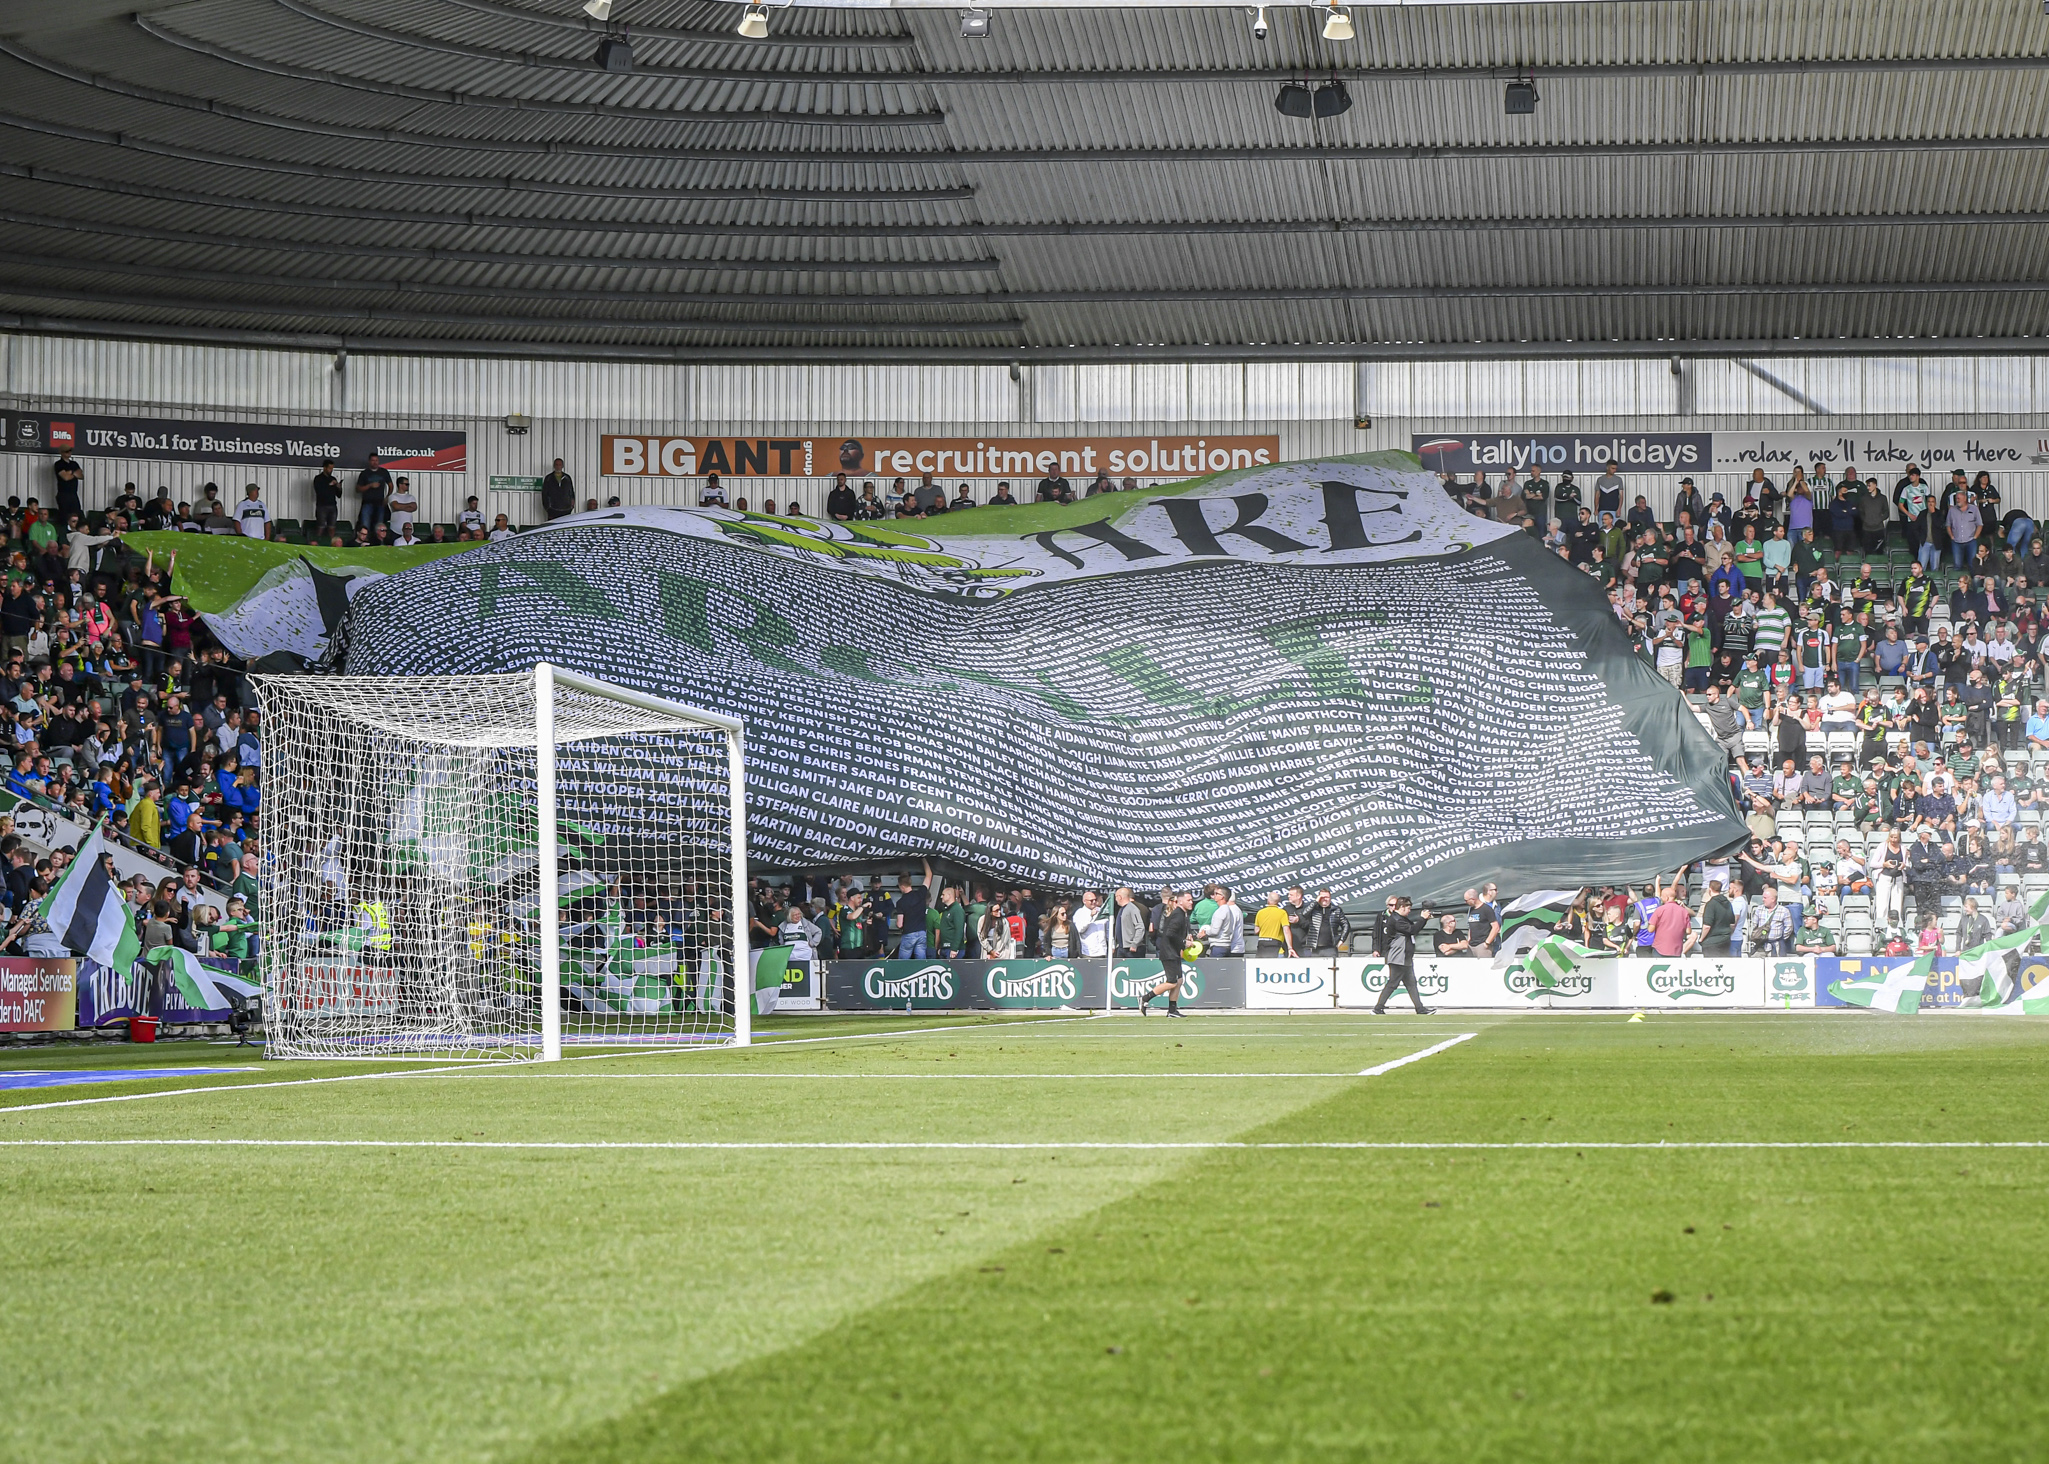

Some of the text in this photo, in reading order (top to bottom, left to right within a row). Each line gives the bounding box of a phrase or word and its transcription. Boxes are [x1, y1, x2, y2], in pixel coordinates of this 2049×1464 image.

[53, 430, 72, 440] Biffa
[86, 429, 341, 458] UK's No.1 for Business Waste
[377, 446, 435, 457] biffa.co.uk
[803, 440, 812, 475] group
[874, 440, 1270, 474] recruitment solutions
[1469, 438, 1697, 470] tallyho holidays
[1809, 437, 1855, 462] we'll
[1863, 438, 1914, 462] take
[1921, 448, 1954, 470] you
[1963, 439, 2022, 462] there
[1020, 480, 1422, 571] ARE
[1388, 562, 1439, 570] BARLOW
[1523, 624, 1570, 632] RENDLE
[1496, 643, 1588, 659] BARRY CORBER
[1523, 640, 1568, 649] MEGAN
[567, 658, 723, 693] KATIE TREHARNE ALAN
[1496, 654, 1582, 670] PEARCE HUGO
[1518, 670, 1598, 682] GODWIN KEITH
[661, 684, 714, 702] SOPHIA
[1372, 680, 1514, 718] DICKSON STRONG
[1528, 682, 1606, 694] CHRIS BIGGS
[826, 703, 877, 720] MOORE
[1225, 700, 1430, 726] CHRIS ARCHARD WILLIAMS
[1285, 709, 1388, 722] NORTHCOTT IAN
[1268, 724, 1364, 739] 'MAVIS' PALMER
[739, 692, 1388, 808] JOHN CORNISH PAUL THOMAS JOHN PLACE KEN HAMBLY ARTHUR
[1218, 740, 1321, 762] MILLIE LUSCOMBE
[754, 717, 1335, 827] KEVIN PARKER BEN SURMAN STEVE BEN ELLACOTT
[760, 731, 1023, 815] JAMES CHRIS JONES FRANK HARPER BEN
[779, 712, 1300, 828] KERRY TECZA ROB BONNEY NORMAN SHAUN
[1228, 754, 1315, 778] MASON HARRIS
[1211, 767, 1315, 798] GOODMAN COLIN
[769, 747, 1351, 868] JON BAKER SARAH DECENT RONALD DIXON CLAIRE DIXON JOSH DIXON
[792, 768, 1416, 874] SMITH JAKE DAY CARA OTTO DAVE SUMMERS JON AND ANGIE PENALUA
[747, 813, 867, 852] MARTIN BARCLAY
[812, 791, 1399, 879] CLAIRE MULLARD ROGER MULLARD JOSH KEAST BARRY JONES
[1630, 822, 1675, 835] SCOTT
[1677, 814, 1726, 828] HARRIS
[753, 832, 803, 853] WHEAT
[756, 795, 1075, 886] STEPHEN LYDDON GARETH JOJO SELLS BEV
[1243, 853, 1360, 891] DUCKETT GAZ HIRD
[1299, 859, 1380, 890] FRANCOMBE
[1351, 846, 1465, 901] HAMMOND DAVID
[1362, 861, 1400, 882] JOHN
[1, 967, 72, 997] Managed Services
[1256, 967, 1310, 984] bond
[1646, 964, 1735, 993] Carlsberg
[90, 961, 154, 1023] TRIBUTE
[1936, 994, 1949, 1003] at
[13, 1000, 22, 1024] to
[23, 998, 46, 1023] PAFC
